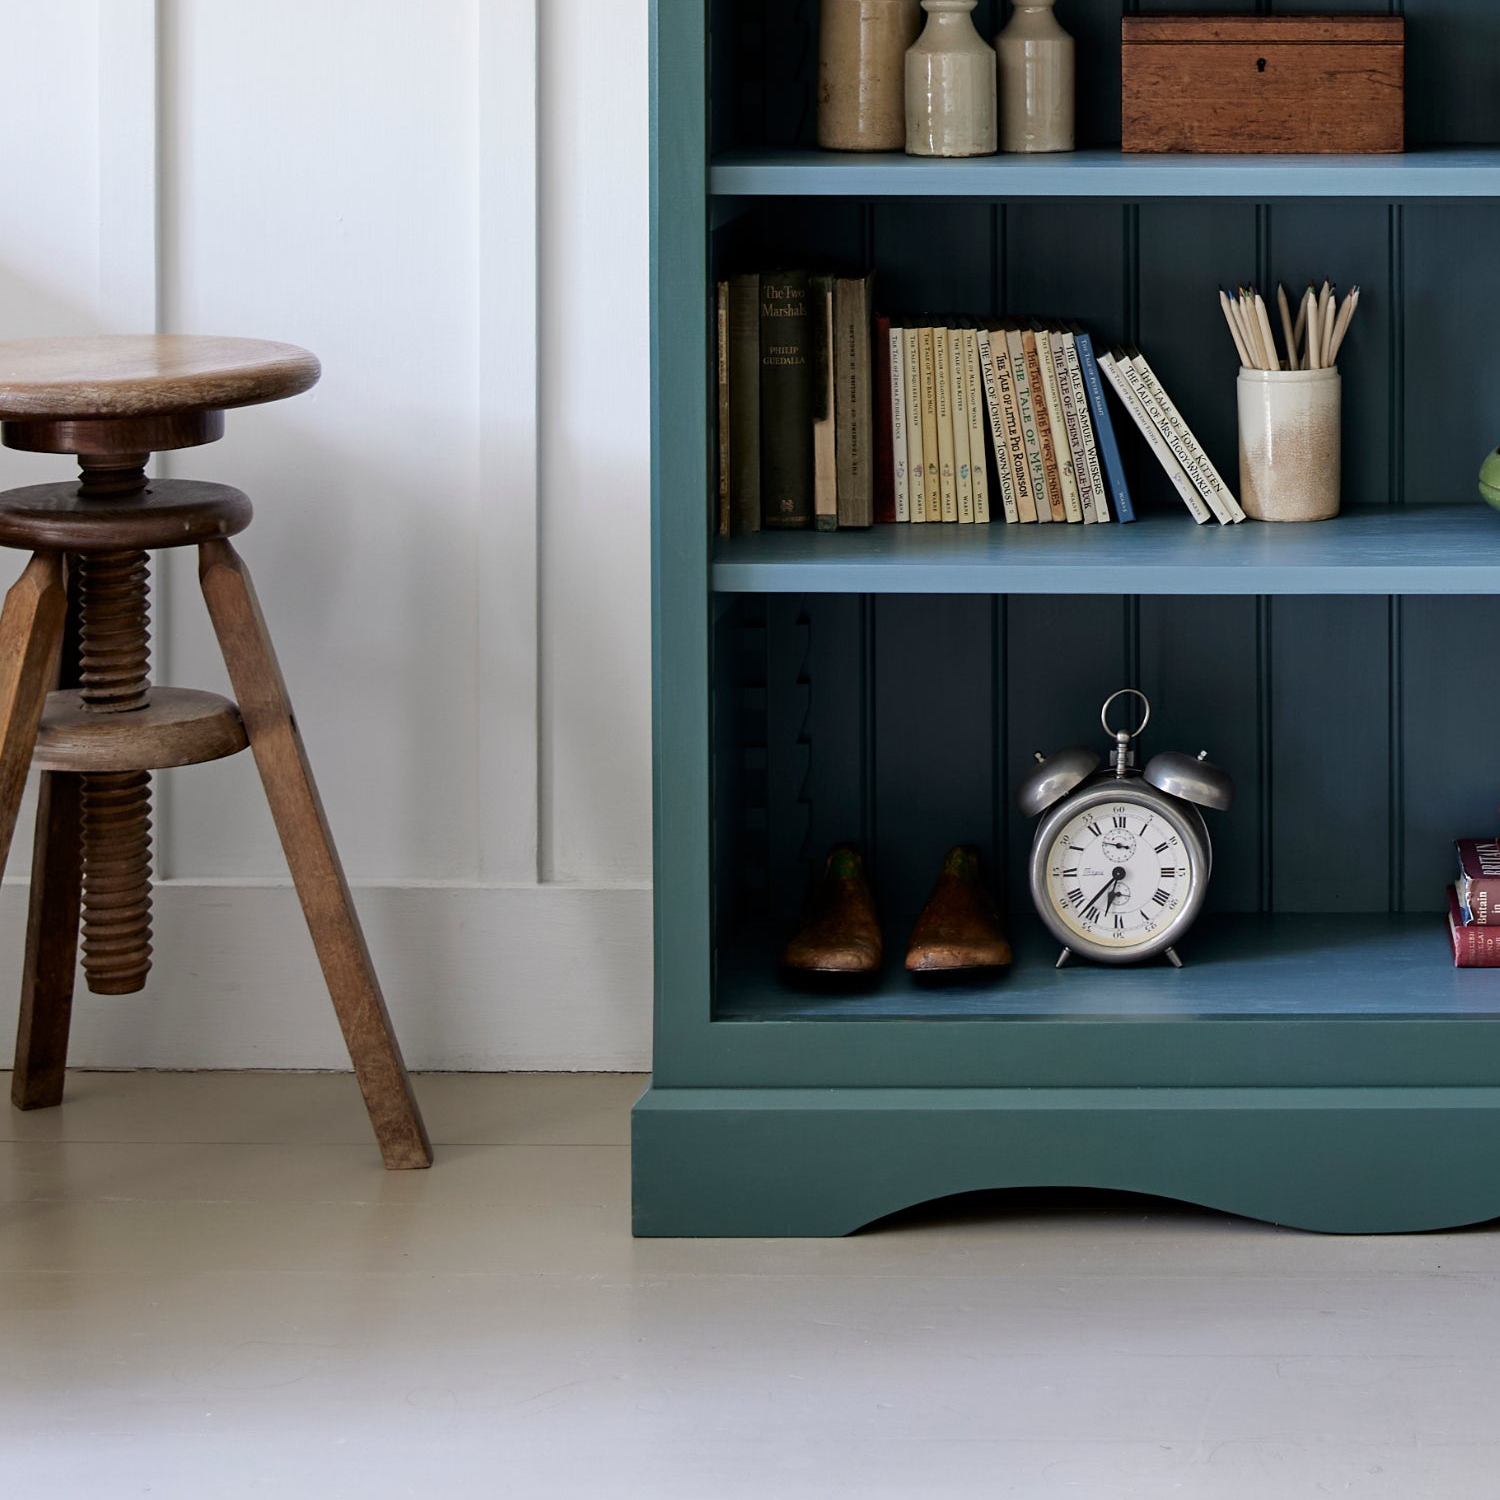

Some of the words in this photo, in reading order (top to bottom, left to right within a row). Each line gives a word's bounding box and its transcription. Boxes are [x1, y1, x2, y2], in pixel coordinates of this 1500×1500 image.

[764, 286, 783, 298] The
[784, 286, 805, 298] Two
[763, 303, 806, 316] Marshals
[980, 340, 990, 359] THE
[1027, 348, 1038, 368] THE
[1053, 347, 1065, 367] THE
[1067, 344, 1076, 363] THE
[982, 360, 993, 383] TALE
[996, 353, 1006, 370] THE
[1013, 354, 1025, 381] THE
[998, 371, 1010, 392] TALE
[1030, 368, 1041, 393] TALE
[1058, 368, 1070, 395] TALE
[1070, 365, 1081, 389] TALE
[1084, 352, 1092, 367] TALE
[1089, 377, 1099, 395] PETER
[1094, 396, 1104, 415] RABBIT
[988, 386, 996, 399] OF
[1004, 395, 1012, 404] OF
[1035, 395, 1044, 407] OF
[1064, 397, 1073, 409] OF
[1076, 392, 1084, 405] OF
[1018, 388, 1031, 423] TALE
[1037, 407, 1048, 427] THE
[990, 402, 1003, 438] JOHNNY
[1005, 407, 1018, 435] LITTLE
[1066, 411, 1079, 448] JEMIMA
[1079, 407, 1091, 445] SAMUEL
[1125, 366, 1142, 385] THE
[1136, 384, 1155, 407] TALE
[1150, 407, 1162, 419] OF
[1170, 436, 1212, 497] TIGGY-WINKLE
[1140, 368, 1157, 389] THE
[1153, 389, 1172, 414] TALE
[1170, 417, 1183, 429] OF
[1180, 430, 1197, 452] TOM
[1195, 454, 1223, 492] KITTEN
[1010, 437, 1021, 451] PIG
[1026, 429, 1035, 446] OF
[997, 442, 1013, 505] TOWN-MOUSE
[1013, 454, 1028, 498] ROBINSON
[1074, 449, 1092, 509] PUDDLE-DUCK
[1087, 447, 1102, 495] WHISKERS
[1033, 474, 1044, 500] TOD
[1047, 465, 1060, 506] BUNNIES
[1161, 868, 1175, 877] III
[1178, 868, 1186, 877] 15
[1478, 892, 1487, 924] Britain
[1492, 904, 1500, 913] in
